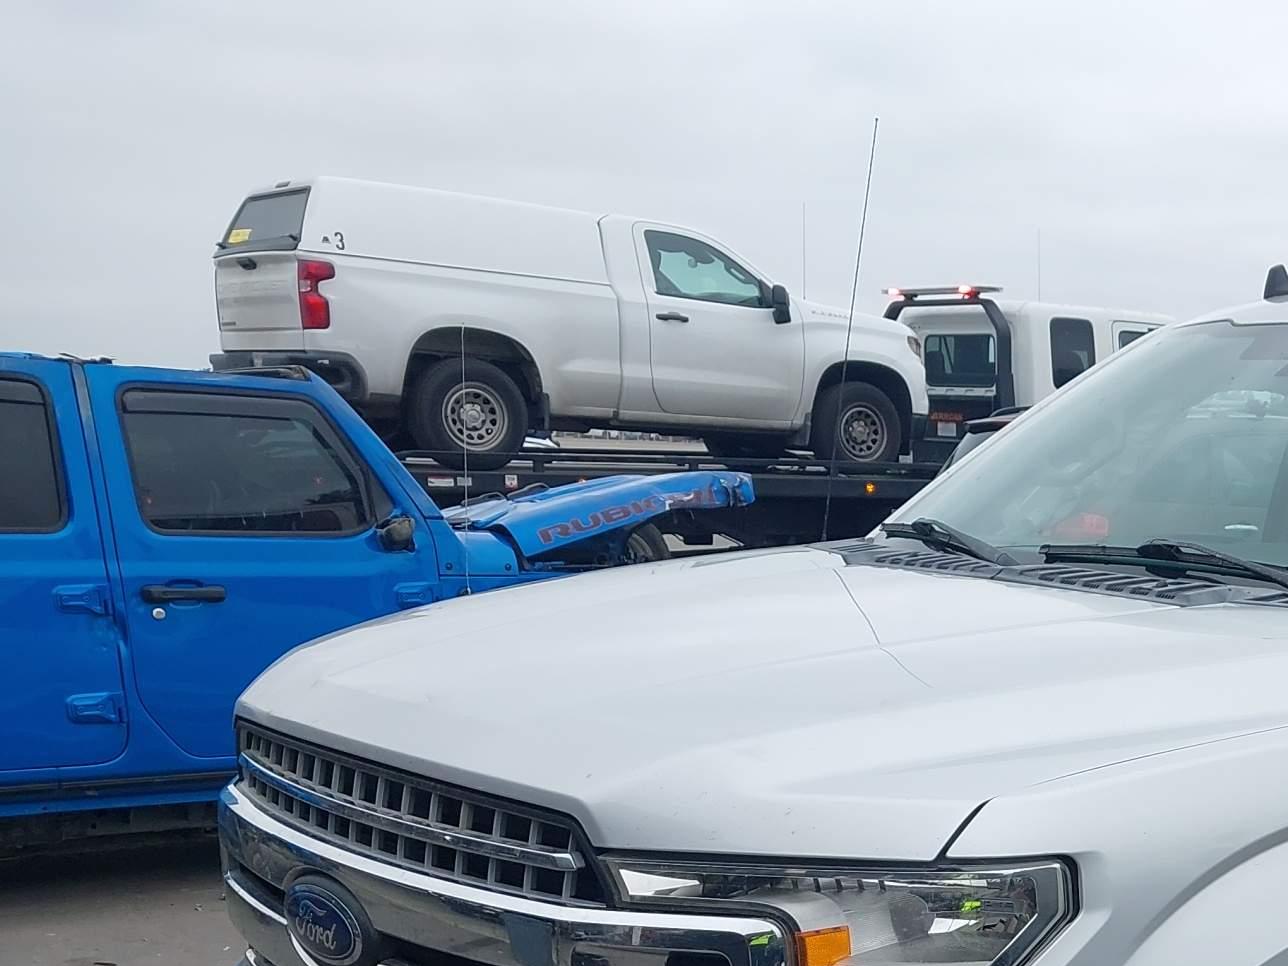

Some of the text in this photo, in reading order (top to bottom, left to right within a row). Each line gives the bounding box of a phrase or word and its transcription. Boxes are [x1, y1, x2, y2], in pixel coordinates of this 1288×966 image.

[334, 231, 345, 250] 3
[538, 486, 714, 543] RUBIC
[295, 899, 337, 950] Ford
